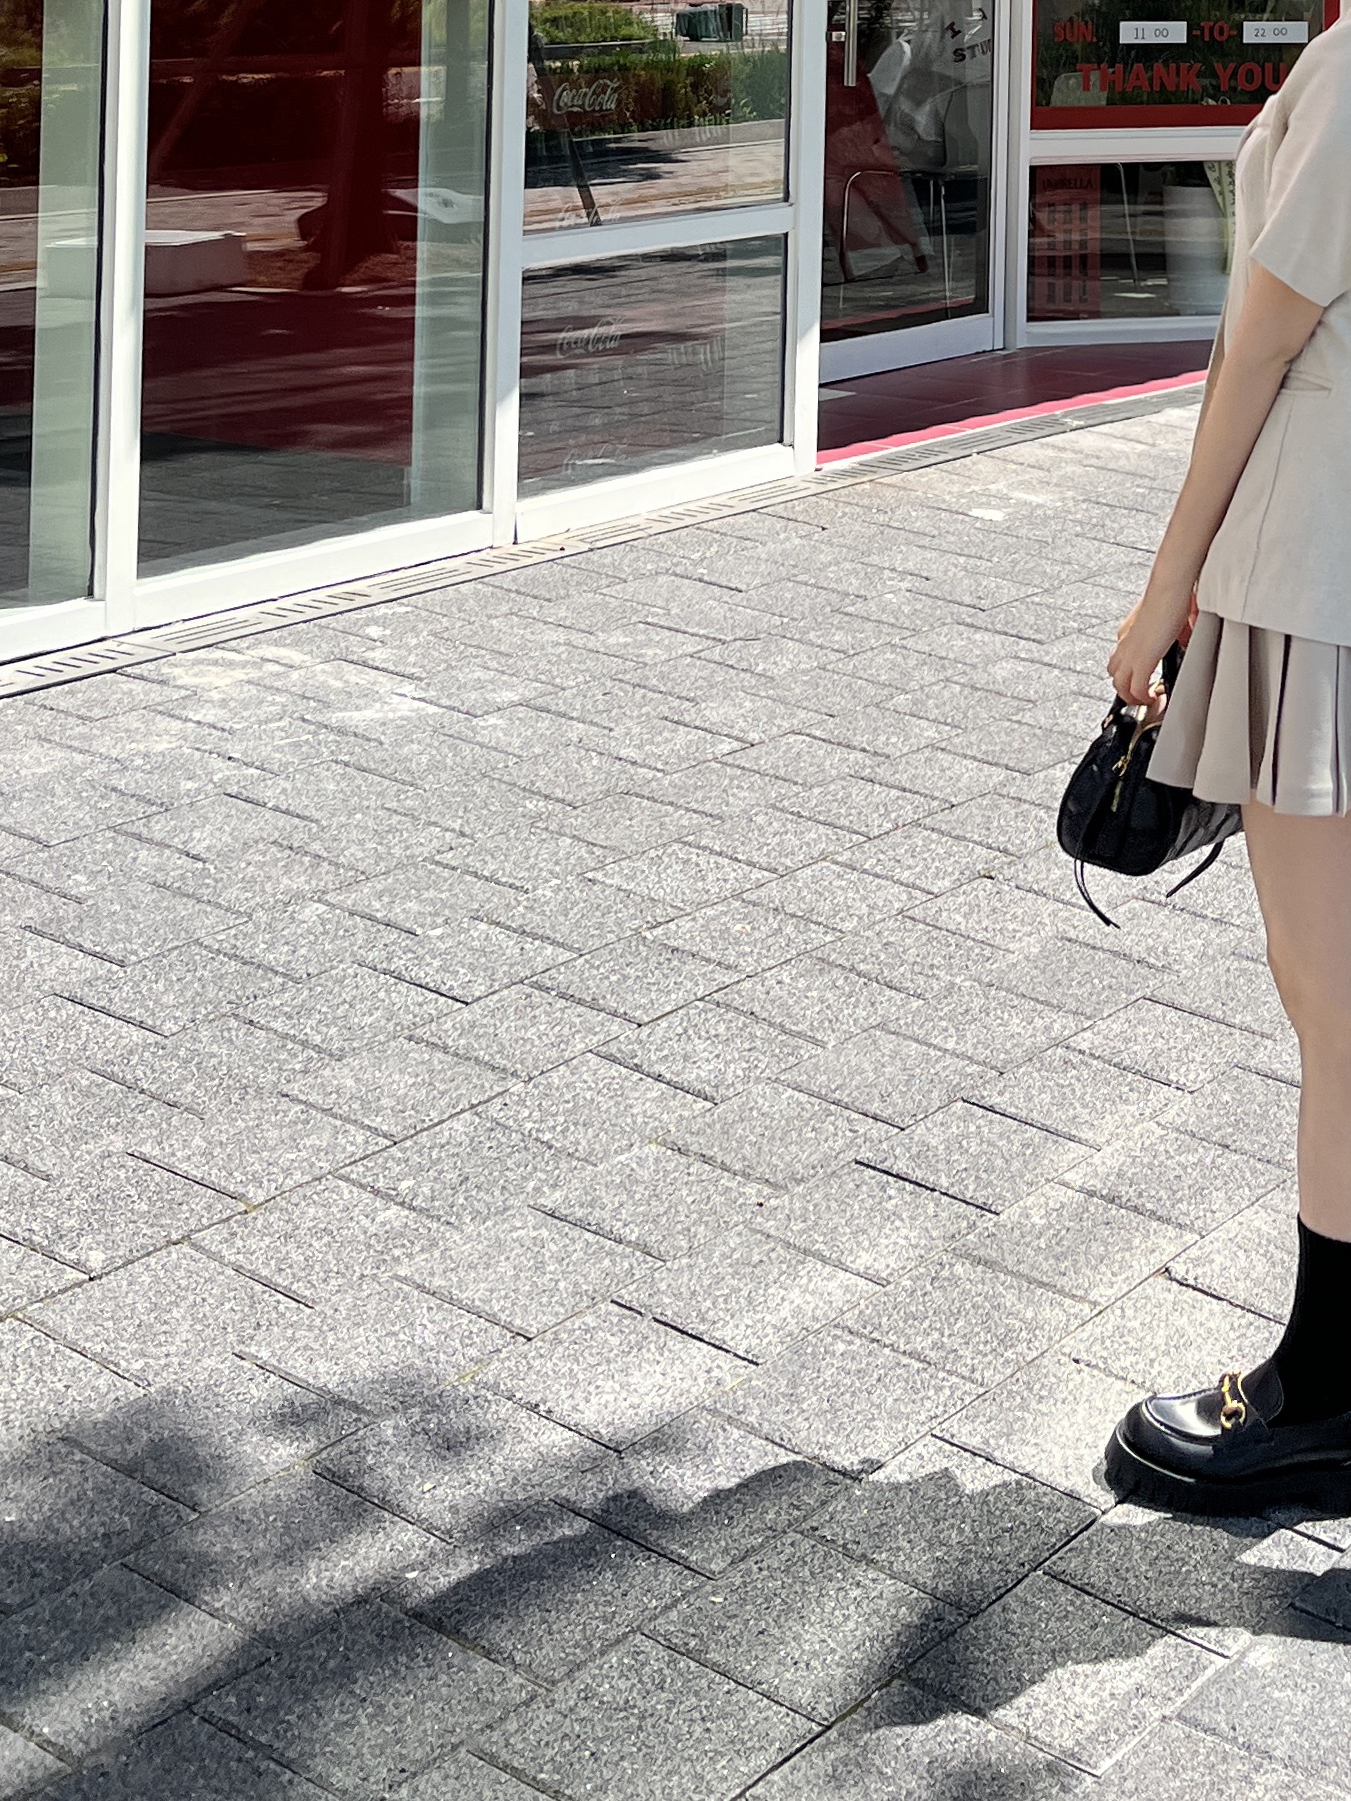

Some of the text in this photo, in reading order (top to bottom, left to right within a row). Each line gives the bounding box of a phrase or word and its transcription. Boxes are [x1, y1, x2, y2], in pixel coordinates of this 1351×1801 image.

[1054, 22, 1098, 43] SUN.
[1192, 21, 1238, 42] -TO-
[1076, 62, 1289, 93] THANK YOU
